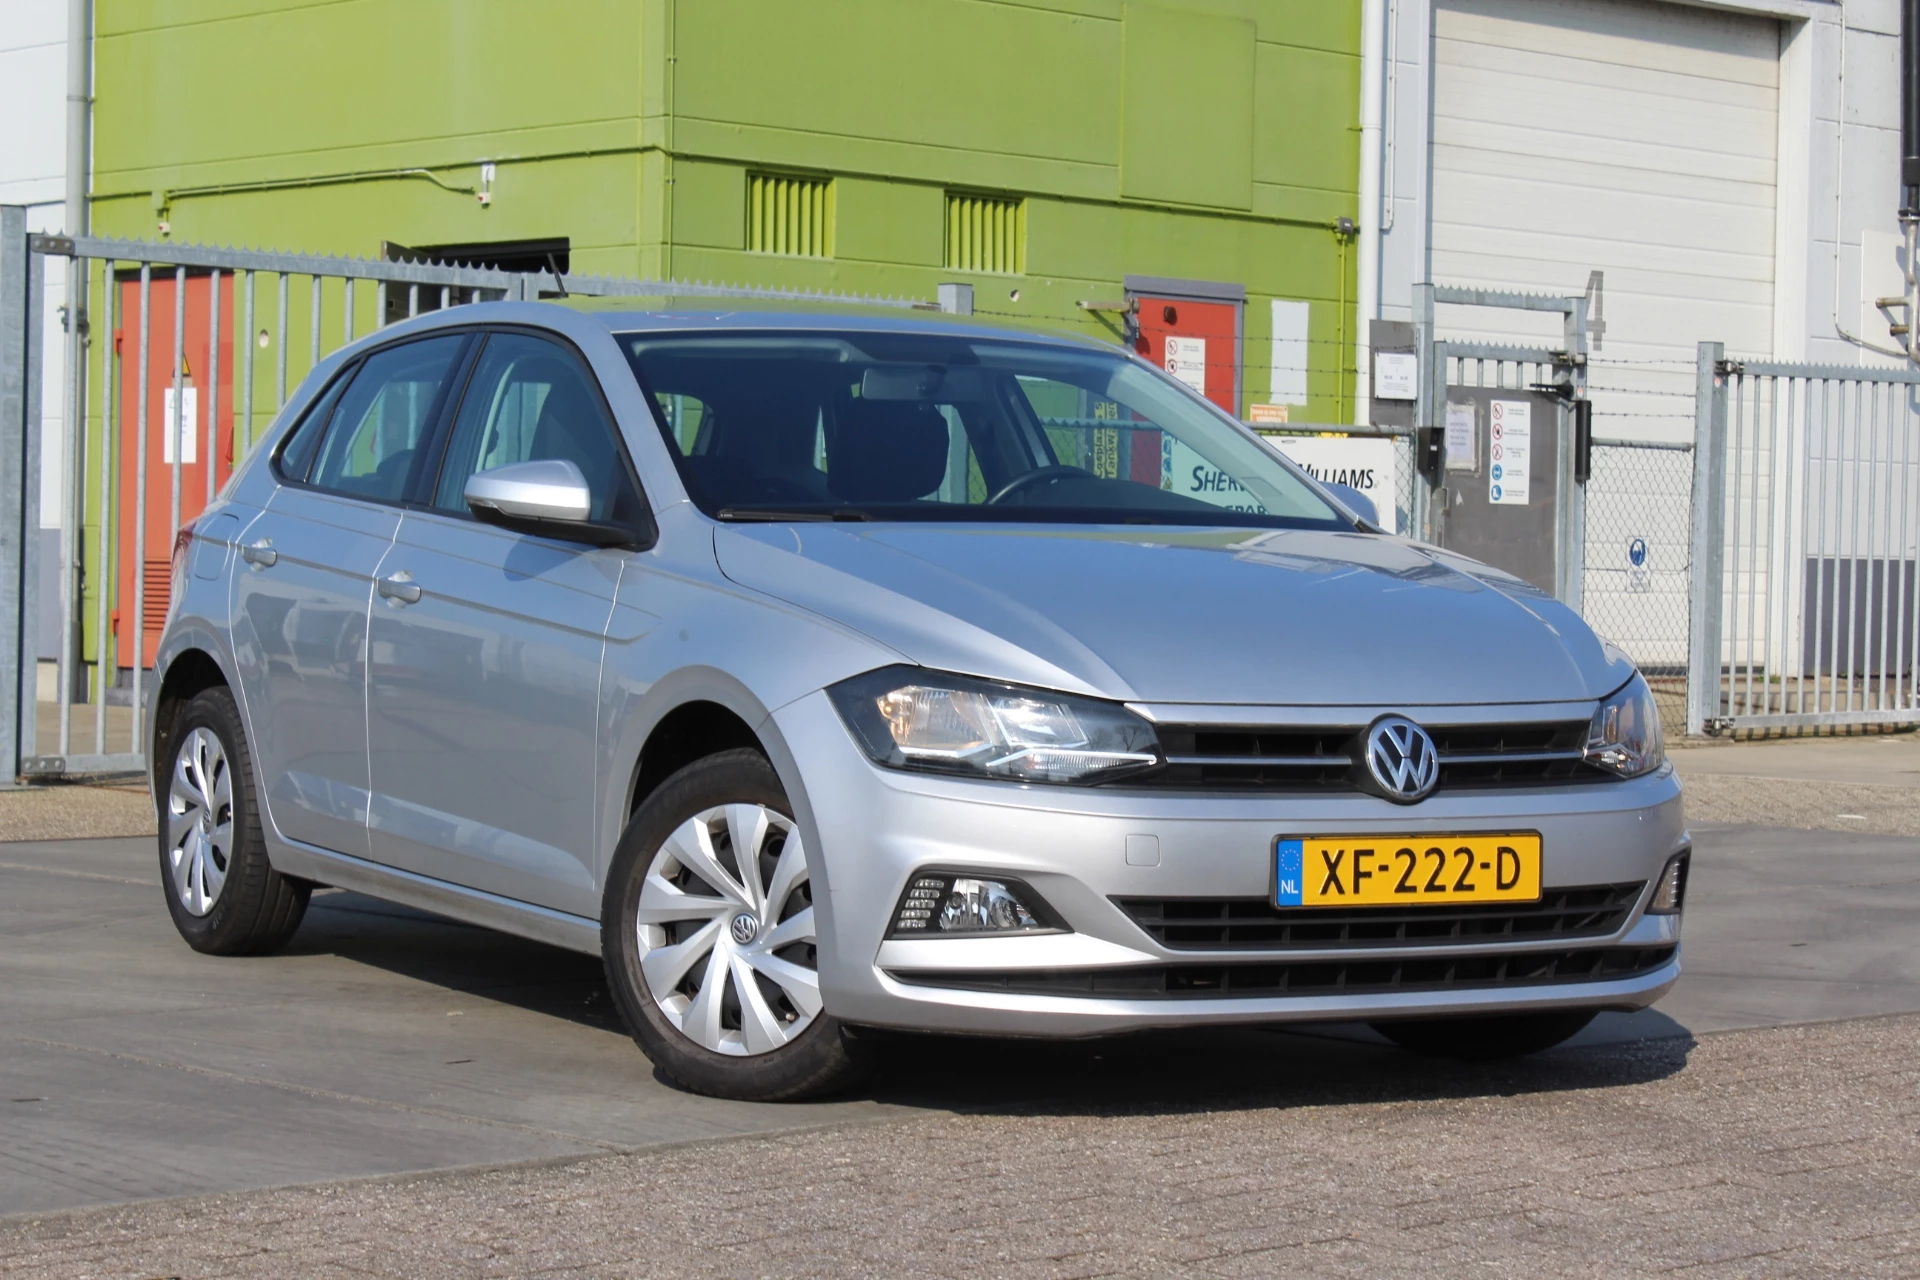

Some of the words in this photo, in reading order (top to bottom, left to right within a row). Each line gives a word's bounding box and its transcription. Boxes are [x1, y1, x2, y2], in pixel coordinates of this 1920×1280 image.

[1585, 270, 1606, 351] 4
[1105, 402, 1115, 478] Tankwaen
[1281, 879, 1299, 894] NL
[1320, 846, 1521, 896] XF-222-D
